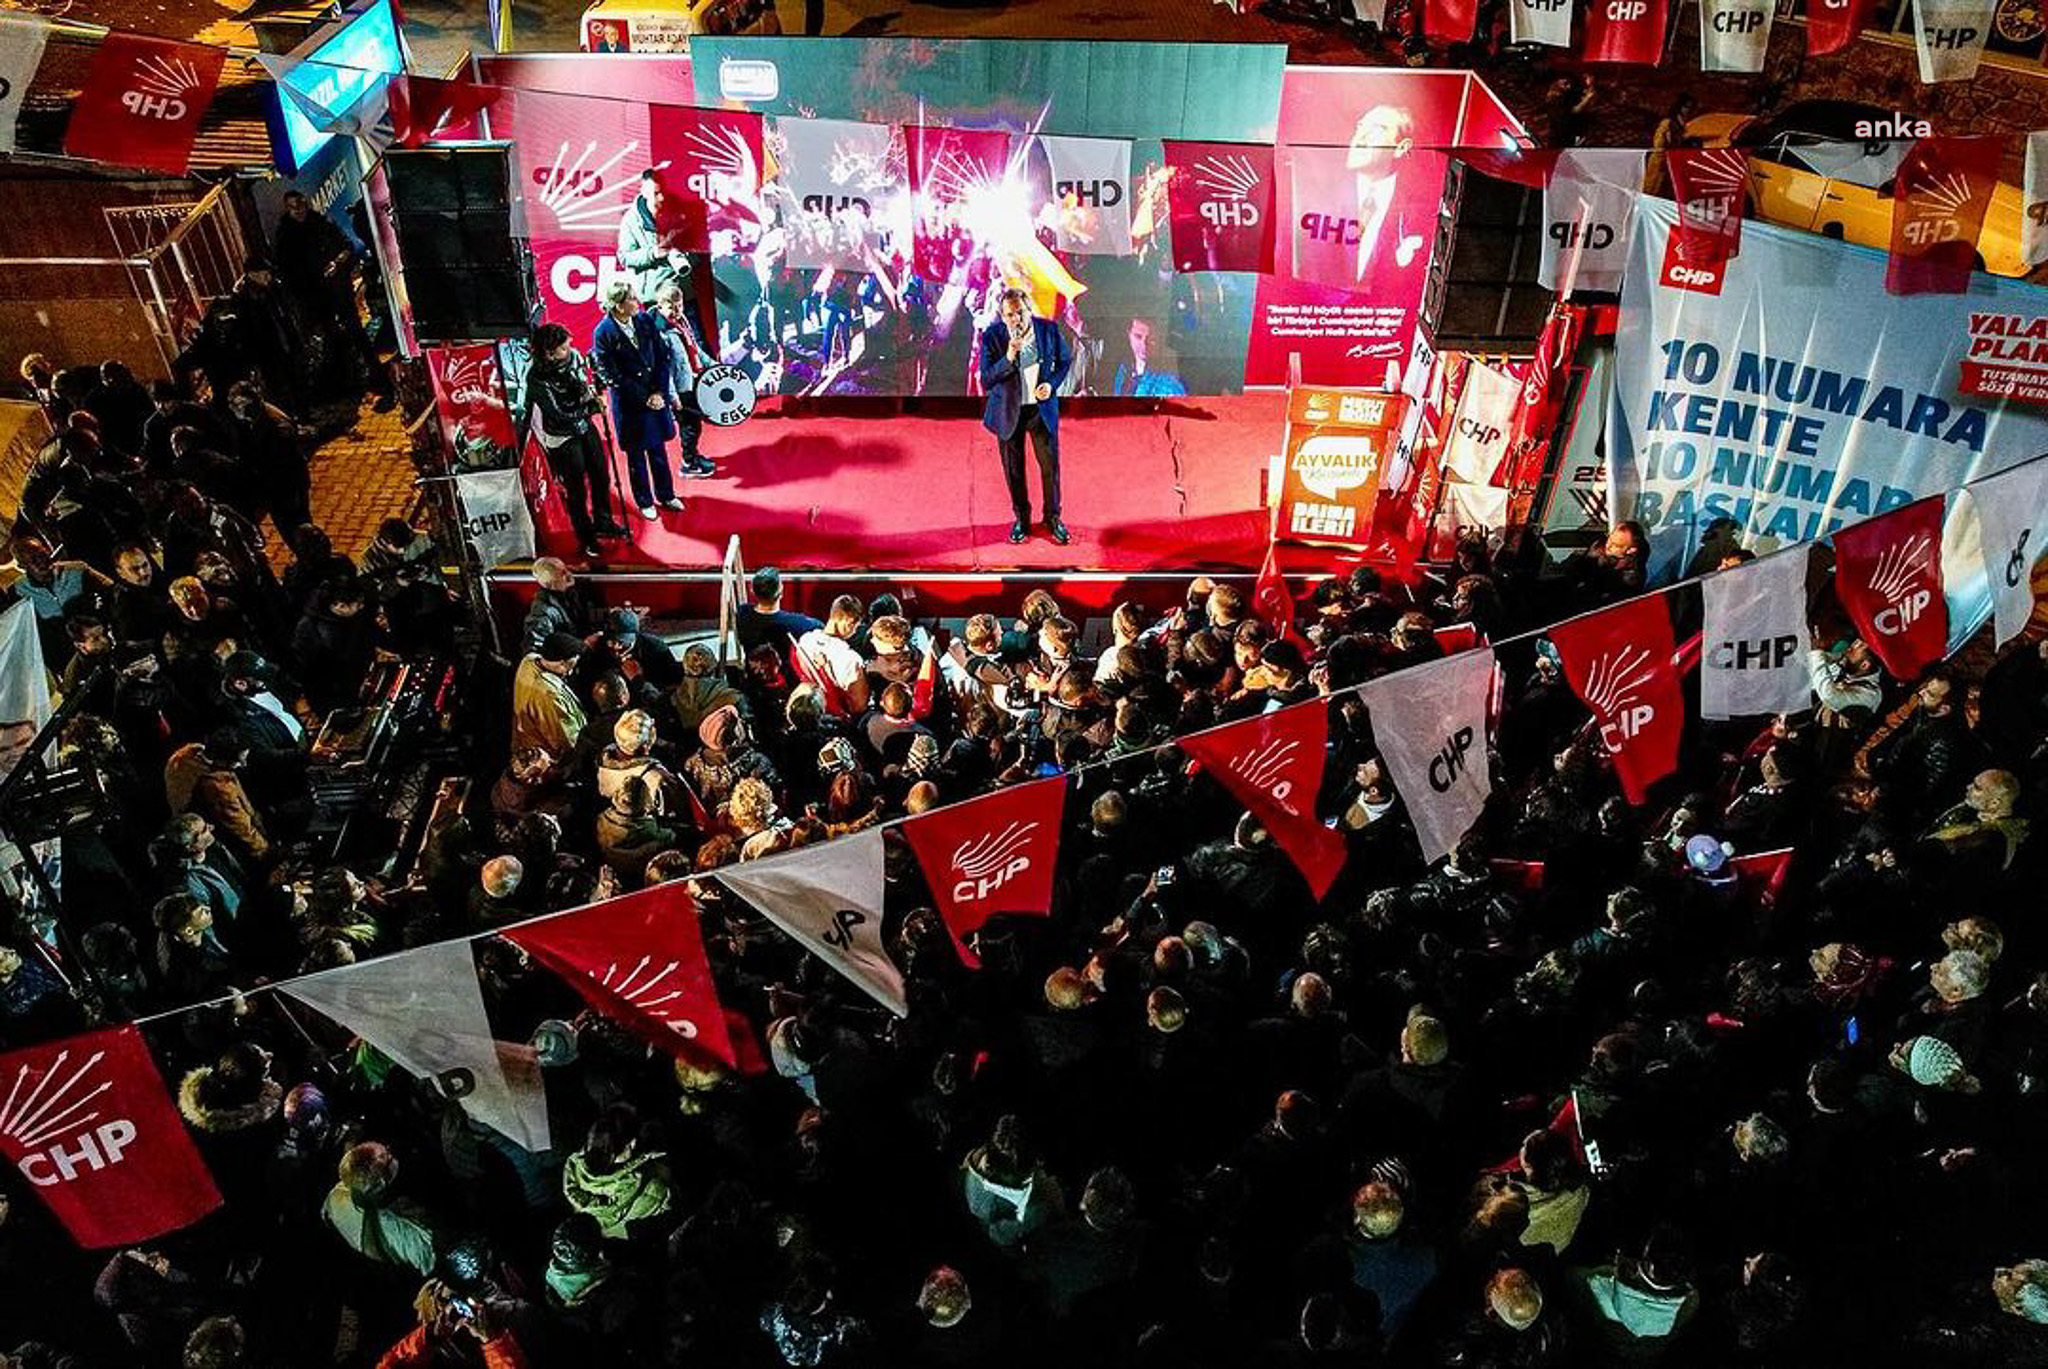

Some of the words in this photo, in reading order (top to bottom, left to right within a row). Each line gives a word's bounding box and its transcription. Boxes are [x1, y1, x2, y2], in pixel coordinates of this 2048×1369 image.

[1607, 1, 1647, 20] CHP
[1713, 11, 1764, 33] CHP
[1669, 265, 1716, 286] CHP
[1661, 339, 1719, 385] 10
[1733, 352, 1987, 452] NUMARA
[1458, 415, 1501, 445] CHP
[1647, 390, 1825, 457] KENTE
[1297, 454, 1372, 467] AYVALIK
[1641, 441, 1697, 481] 10
[470, 512, 511, 537] CHP
[1709, 634, 1798, 670] CHP
[1428, 726, 1473, 794] CHP
[953, 856, 1031, 903] CHP
[17, 1119, 138, 1187] CHP
